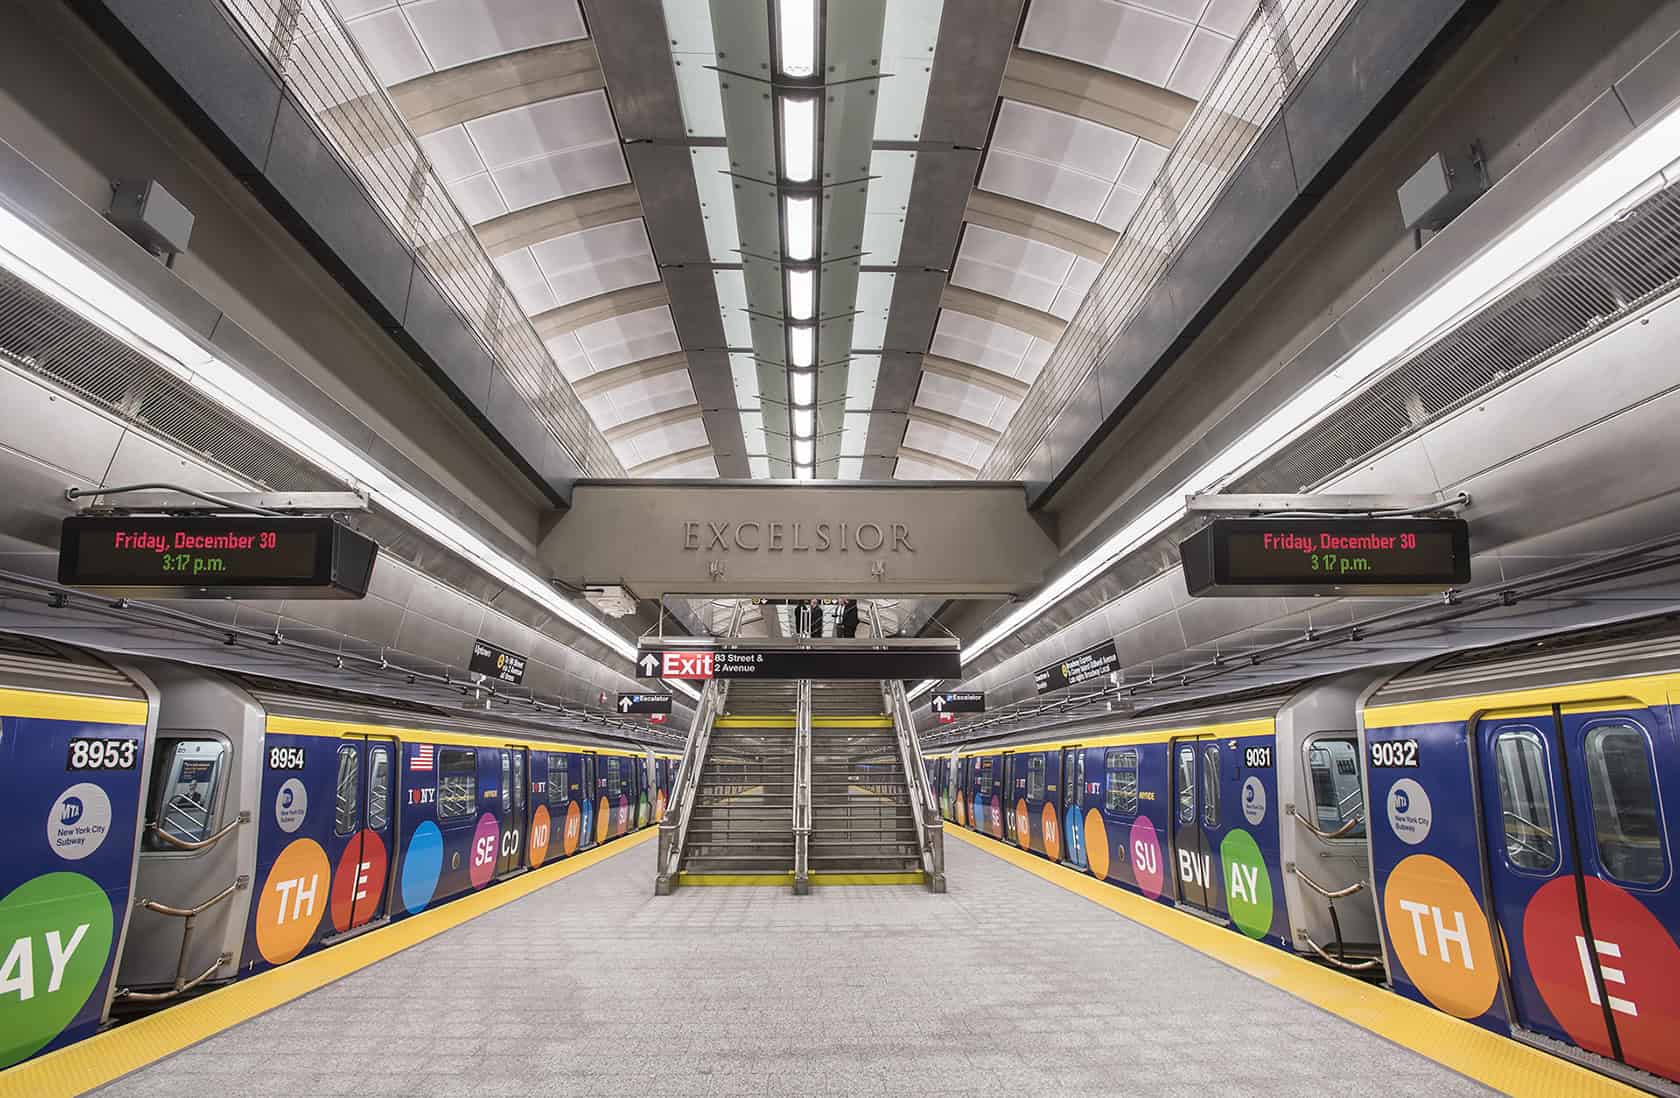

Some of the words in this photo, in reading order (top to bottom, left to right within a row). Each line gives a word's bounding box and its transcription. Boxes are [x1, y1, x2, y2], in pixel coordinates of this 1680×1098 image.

[115, 532, 170, 553] Friday,
[175, 532, 254, 549] December
[259, 532, 277, 549] 30
[683, 521, 916, 552] EXCELSIOR
[1264, 533, 1318, 553] Friday,
[1321, 533, 1397, 550] December
[1400, 533, 1417, 550] 30
[162, 554, 190, 571] 3:17
[193, 557, 227, 575] p.m.
[1340, 558, 1372, 575] p.m.
[663, 653, 713, 675] Exit
[728, 654, 755, 662] Street
[757, 654, 763, 662] &
[714, 664, 721, 672] 2
[722, 663, 756, 672] Avenue
[72, 740, 134, 768] 8953
[271, 748, 304, 769] 8954
[1246, 748, 1271, 767] 9031
[1372, 742, 1417, 767] 9032
[408, 789, 413, 804] I
[420, 788, 435, 803] NY
[59, 803, 80, 821] MTA
[58, 828, 74, 837] New
[75, 826, 91, 835] York
[92, 824, 106, 834] City
[56, 837, 86, 848] Subway
[475, 835, 495, 867] SE
[502, 829, 519, 857] CO
[533, 824, 547, 849] ND
[1135, 840, 1157, 875] SU
[1178, 848, 1210, 889] BW
[1231, 862, 1258, 905] AY
[275, 873, 319, 926] TH
[352, 862, 371, 902] E
[0, 923, 90, 1001] AY
[1400, 899, 1475, 971] TH
[1575, 935, 1638, 1017] E
